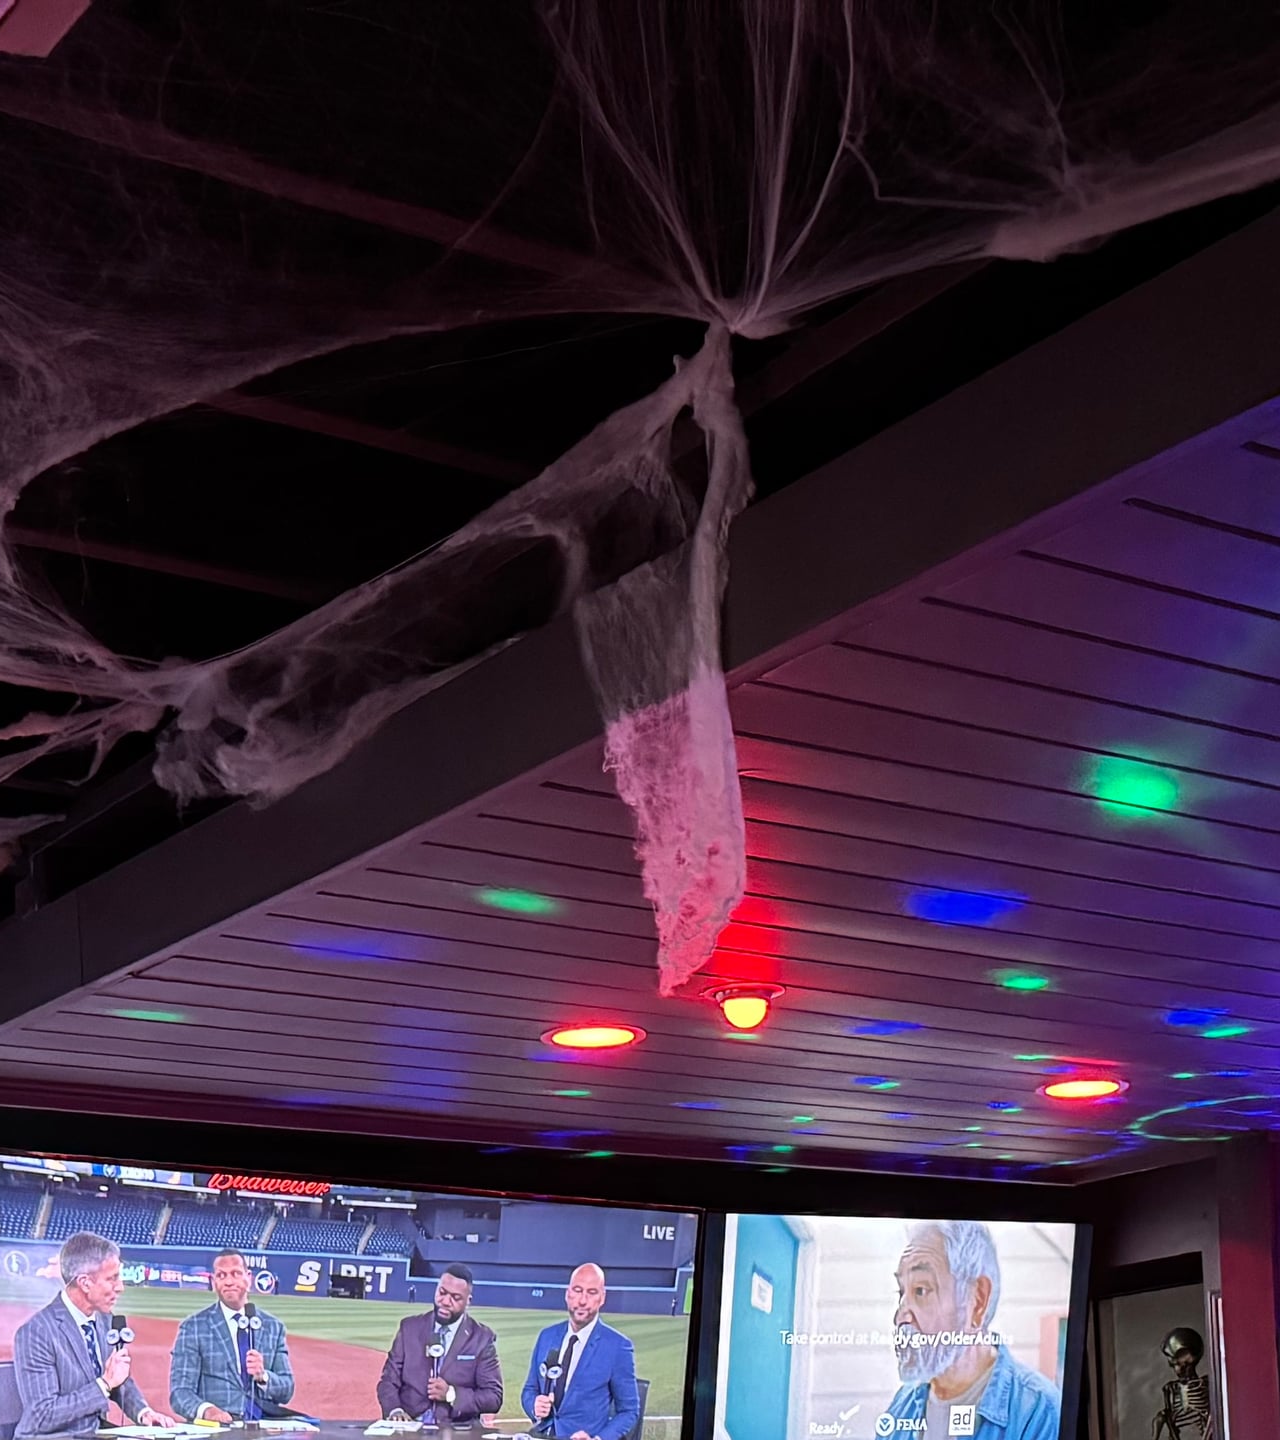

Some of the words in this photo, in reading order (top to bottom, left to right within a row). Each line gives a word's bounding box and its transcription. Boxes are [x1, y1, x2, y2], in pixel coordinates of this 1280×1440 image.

[643, 1224, 675, 1241] LIVE
[780, 1330, 808, 1345] Take
[810, 1330, 853, 1345] control
[854, 1332, 869, 1345] at
[896, 1418, 928, 1431] FEMA
